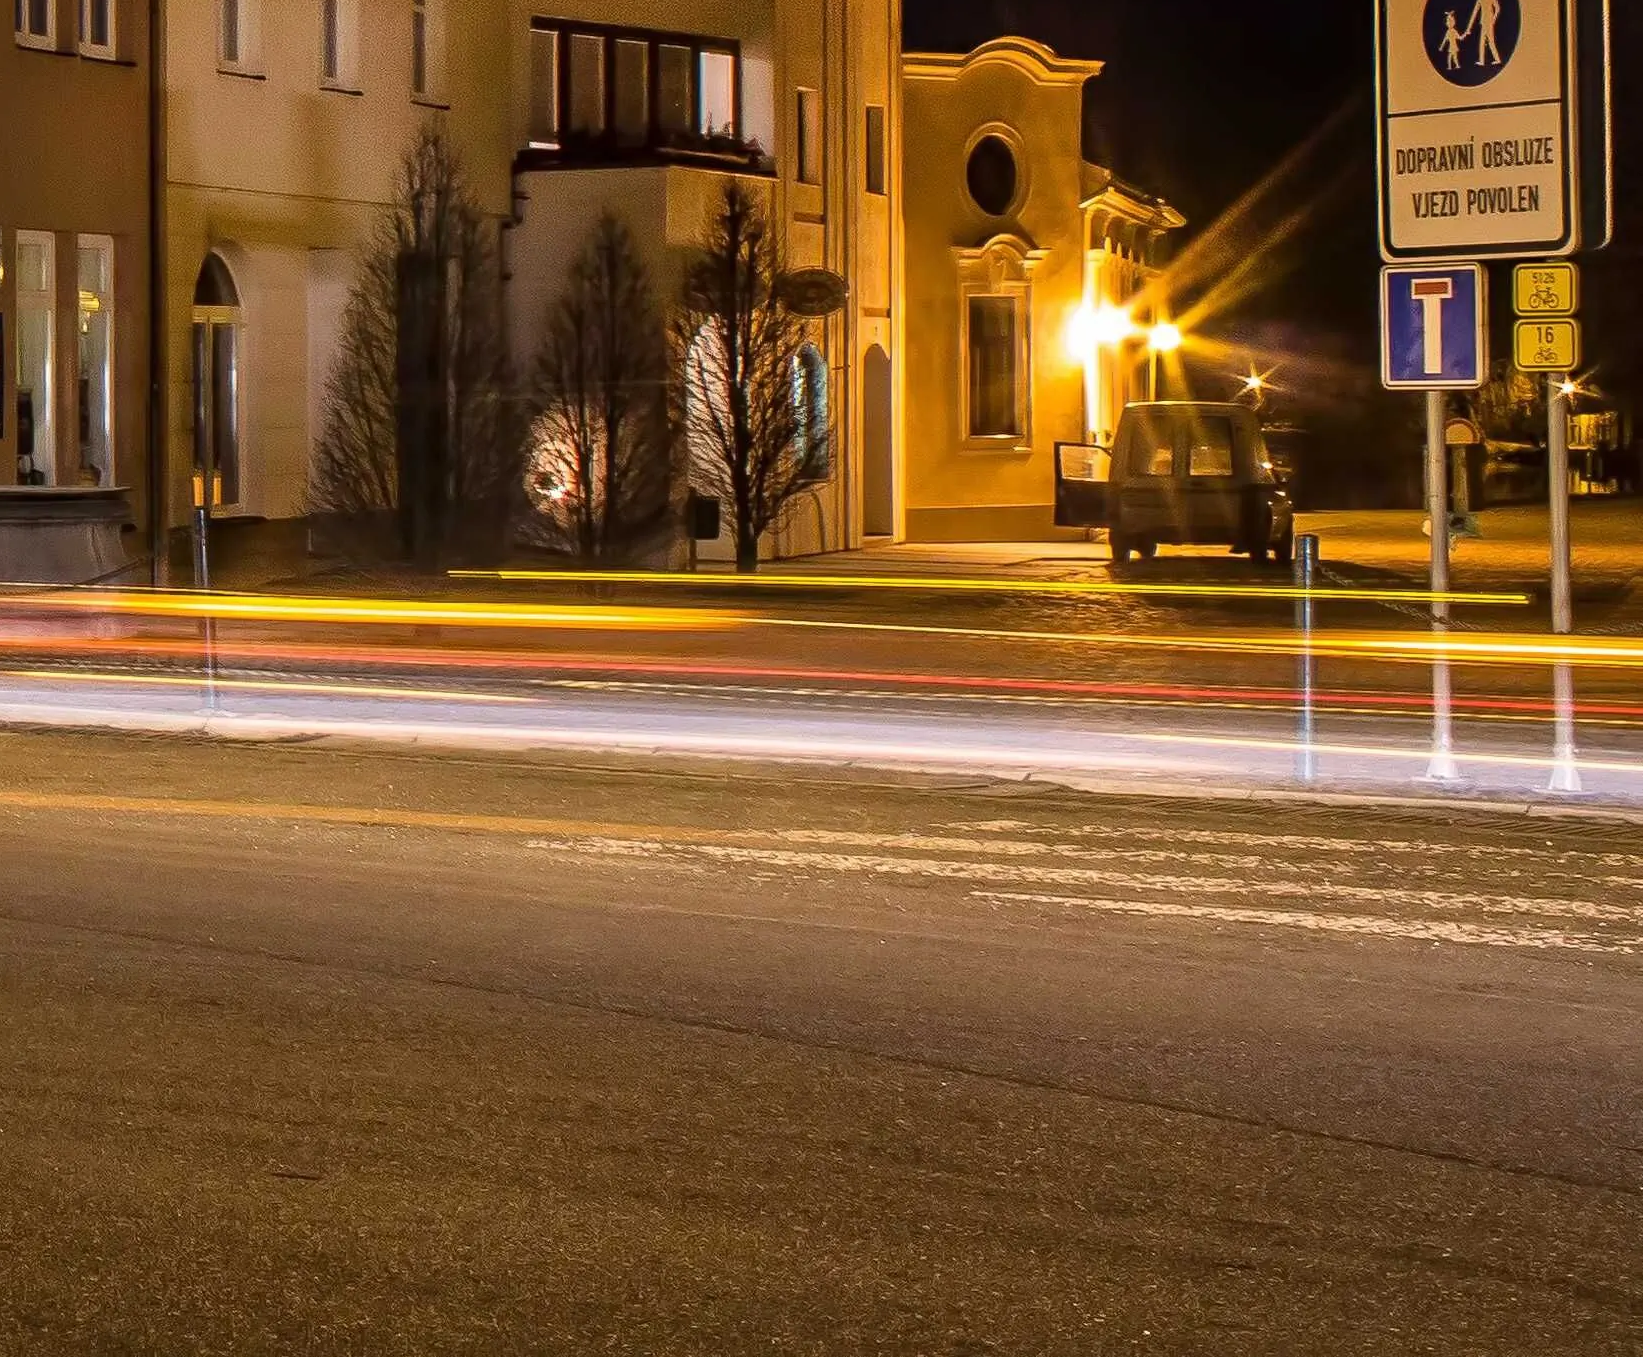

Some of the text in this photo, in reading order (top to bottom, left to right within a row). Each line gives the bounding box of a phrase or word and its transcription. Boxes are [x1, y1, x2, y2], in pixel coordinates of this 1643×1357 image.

[1396, 136, 1554, 175] DOPRAVNÍ OBSLUZE
[1412, 185, 1539, 219] VJEZD POVOLEN
[1536, 326, 1554, 343] 16
